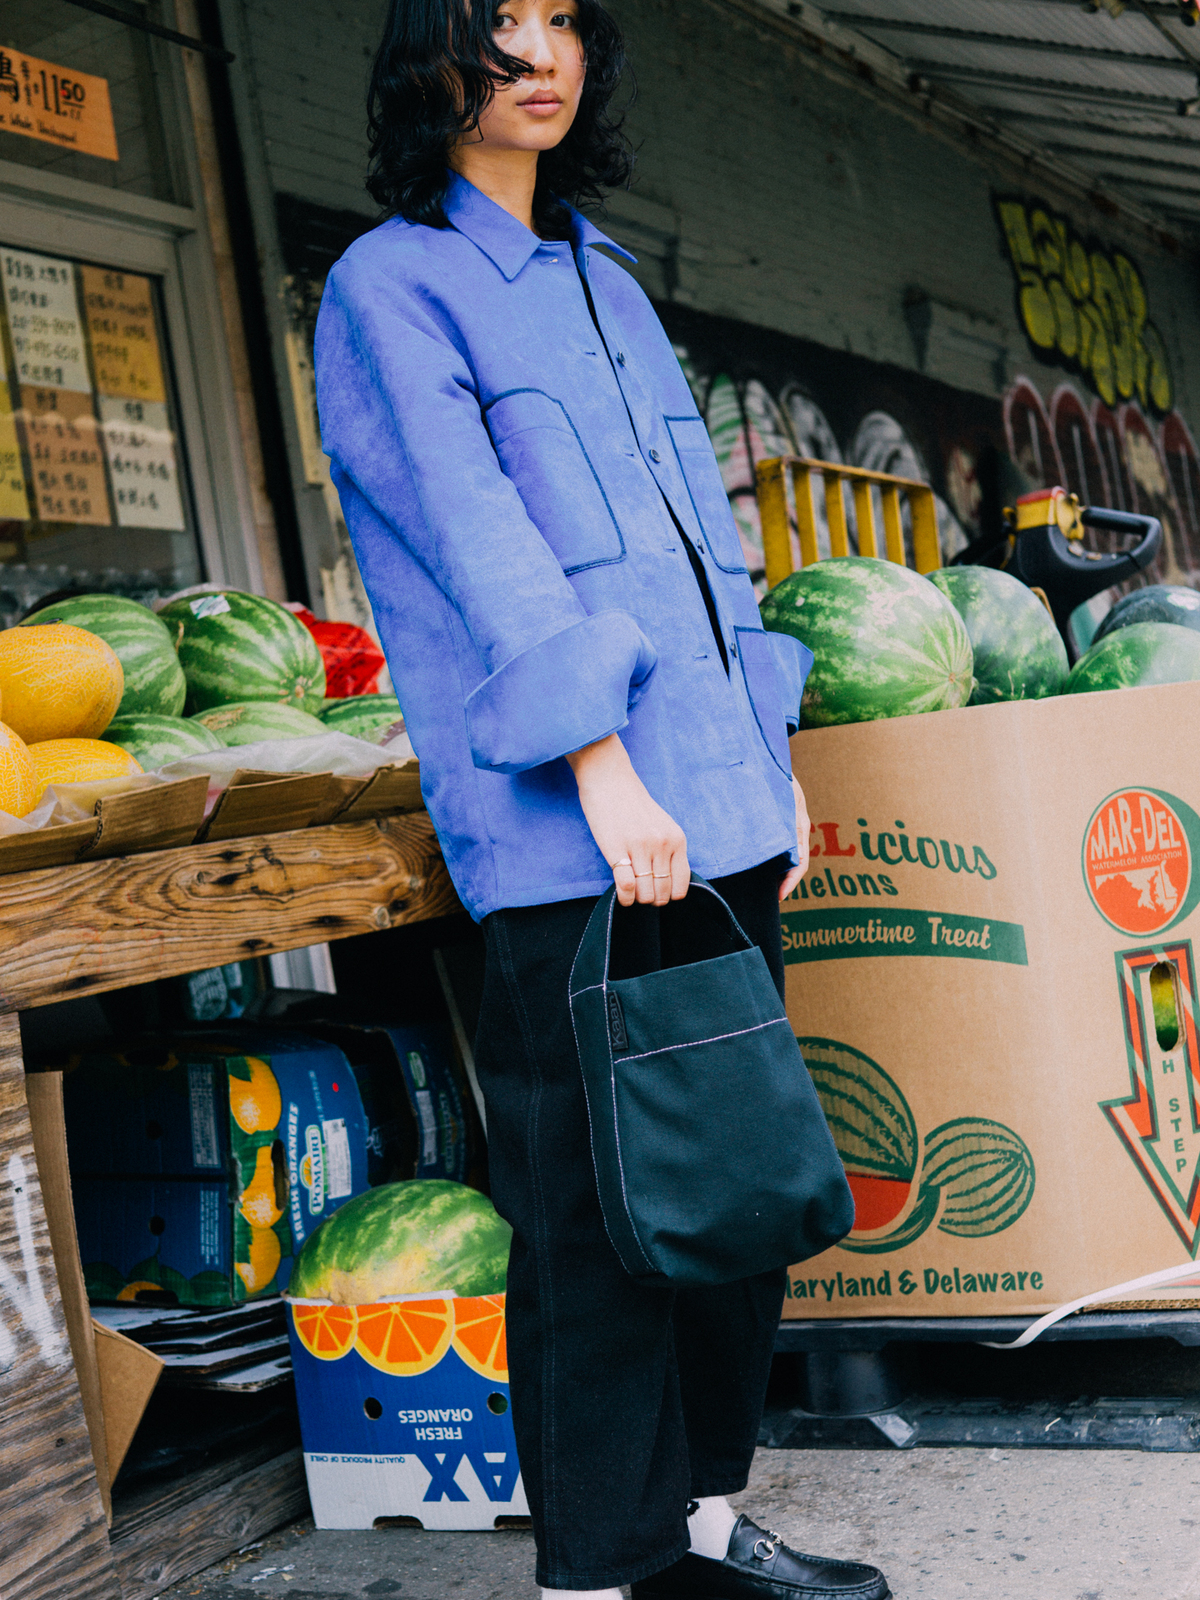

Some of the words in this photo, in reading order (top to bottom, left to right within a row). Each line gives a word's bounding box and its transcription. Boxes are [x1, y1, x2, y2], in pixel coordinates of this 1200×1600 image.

[1090, 796, 1181, 861] MAR-DEL
[1092, 857, 1137, 871] WATERMELON
[1141, 850, 1182, 864] ASSOCIATION
[780, 918, 916, 951] Summertime
[927, 917, 991, 950] Treat
[289, 1102, 299, 1187] ORANGES
[1168, 1098, 1187, 1173] STEP
[310, 1131, 322, 1208] POMAIRE
[290, 1188, 305, 1242] FRESH
[897, 1269, 918, 1295] &
[923, 1267, 1044, 1295] Delaware
[398, 1408, 473, 1424] ORANGES
[415, 1427, 463, 1441] FRESH
[310, 1455, 328, 1463] CHILE
[341, 1456, 372, 1464] PRODUCE
[374, 1456, 405, 1464] QUALITY
